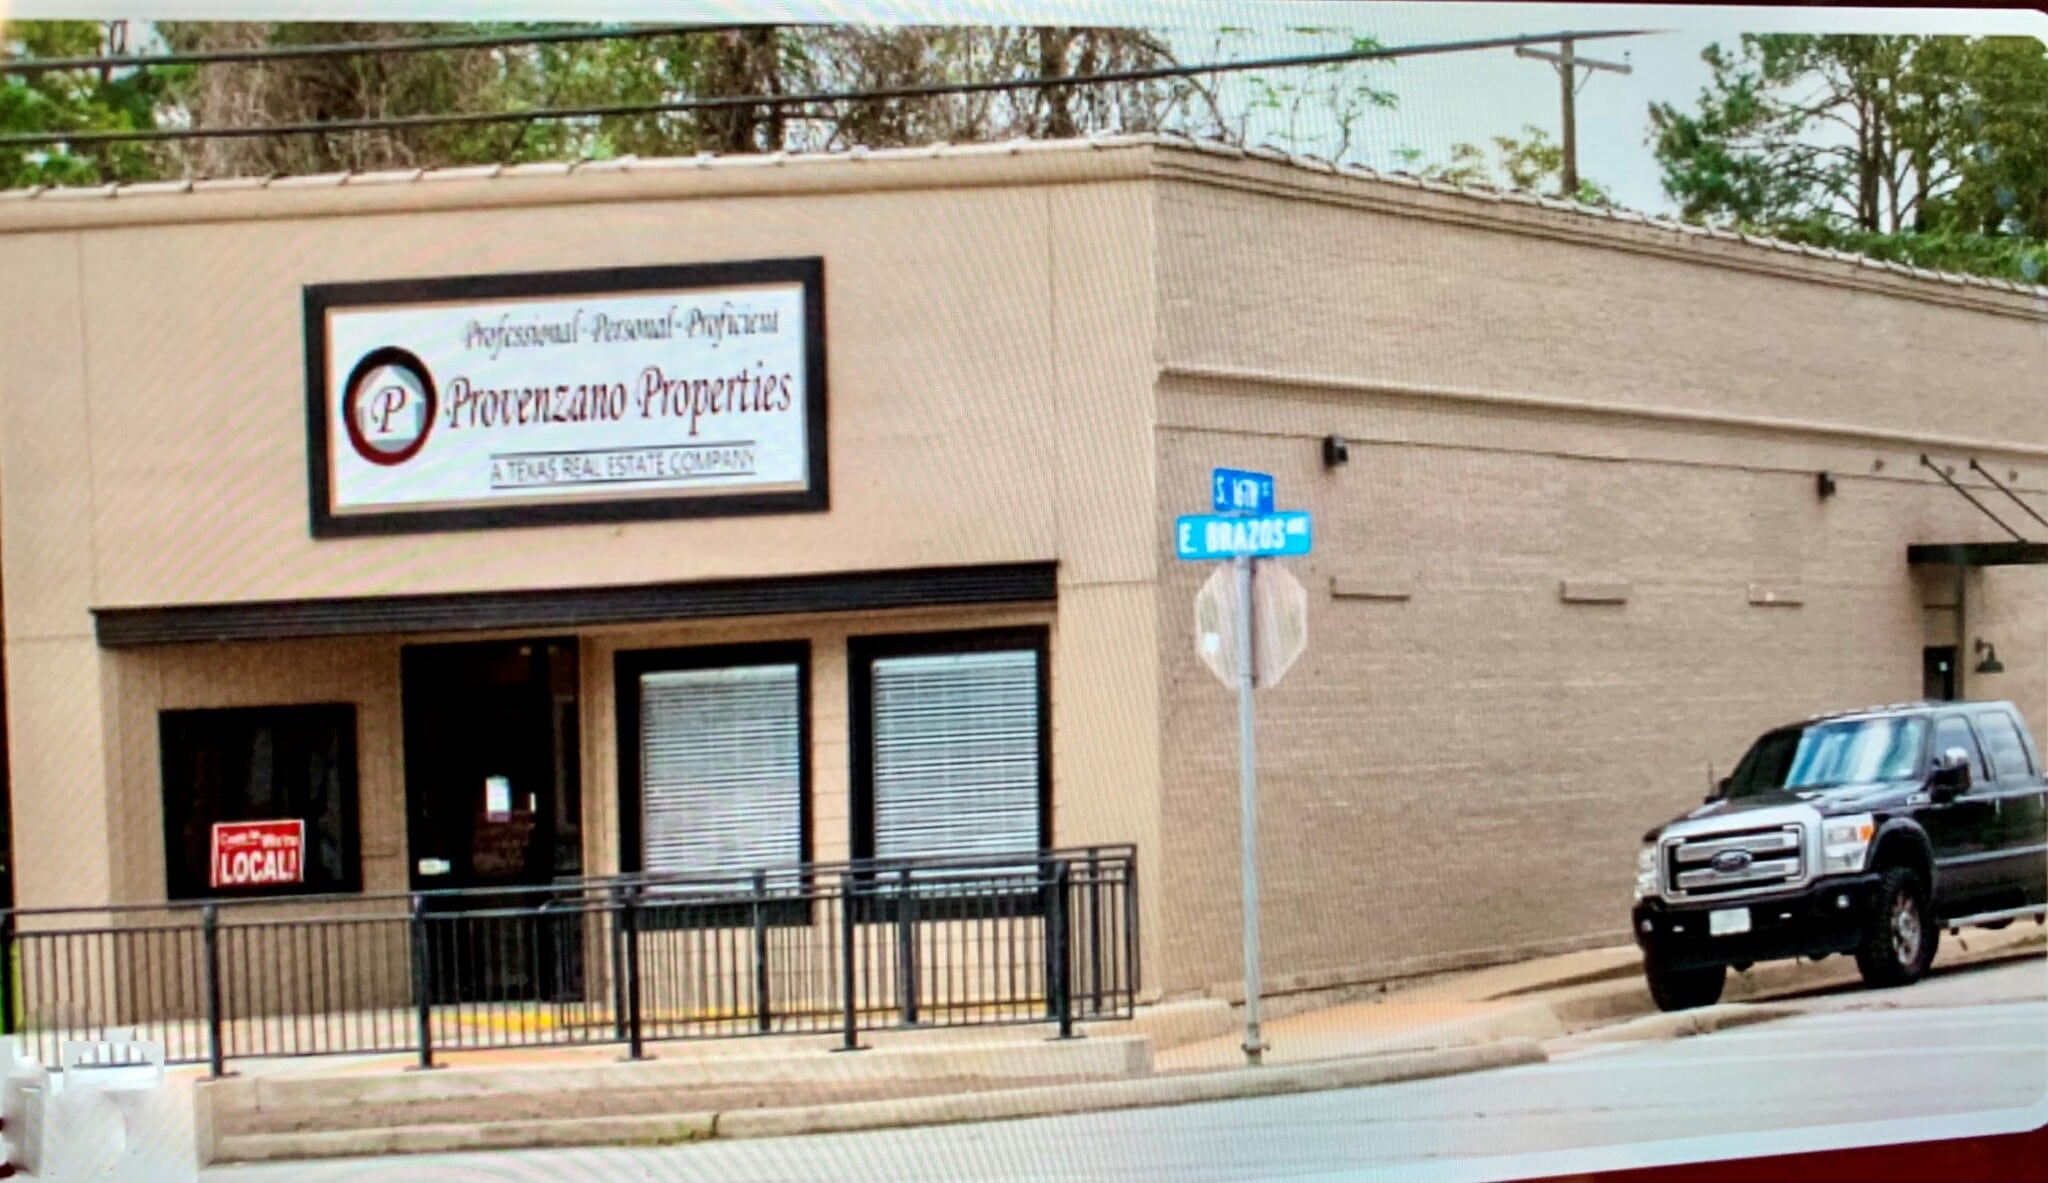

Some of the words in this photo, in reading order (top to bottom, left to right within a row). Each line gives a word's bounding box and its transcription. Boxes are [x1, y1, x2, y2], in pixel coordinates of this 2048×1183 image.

[371, 385, 406, 433] P
[445, 376, 628, 429] Provenzano
[636, 360, 793, 436] Properties
[490, 461, 504, 481] A
[507, 457, 556, 482] TEXAS
[563, 456, 602, 479] REAL
[606, 452, 666, 477] ESTATE
[669, 448, 756, 475] COMPANY
[221, 848, 298, 884] LOCAL!
